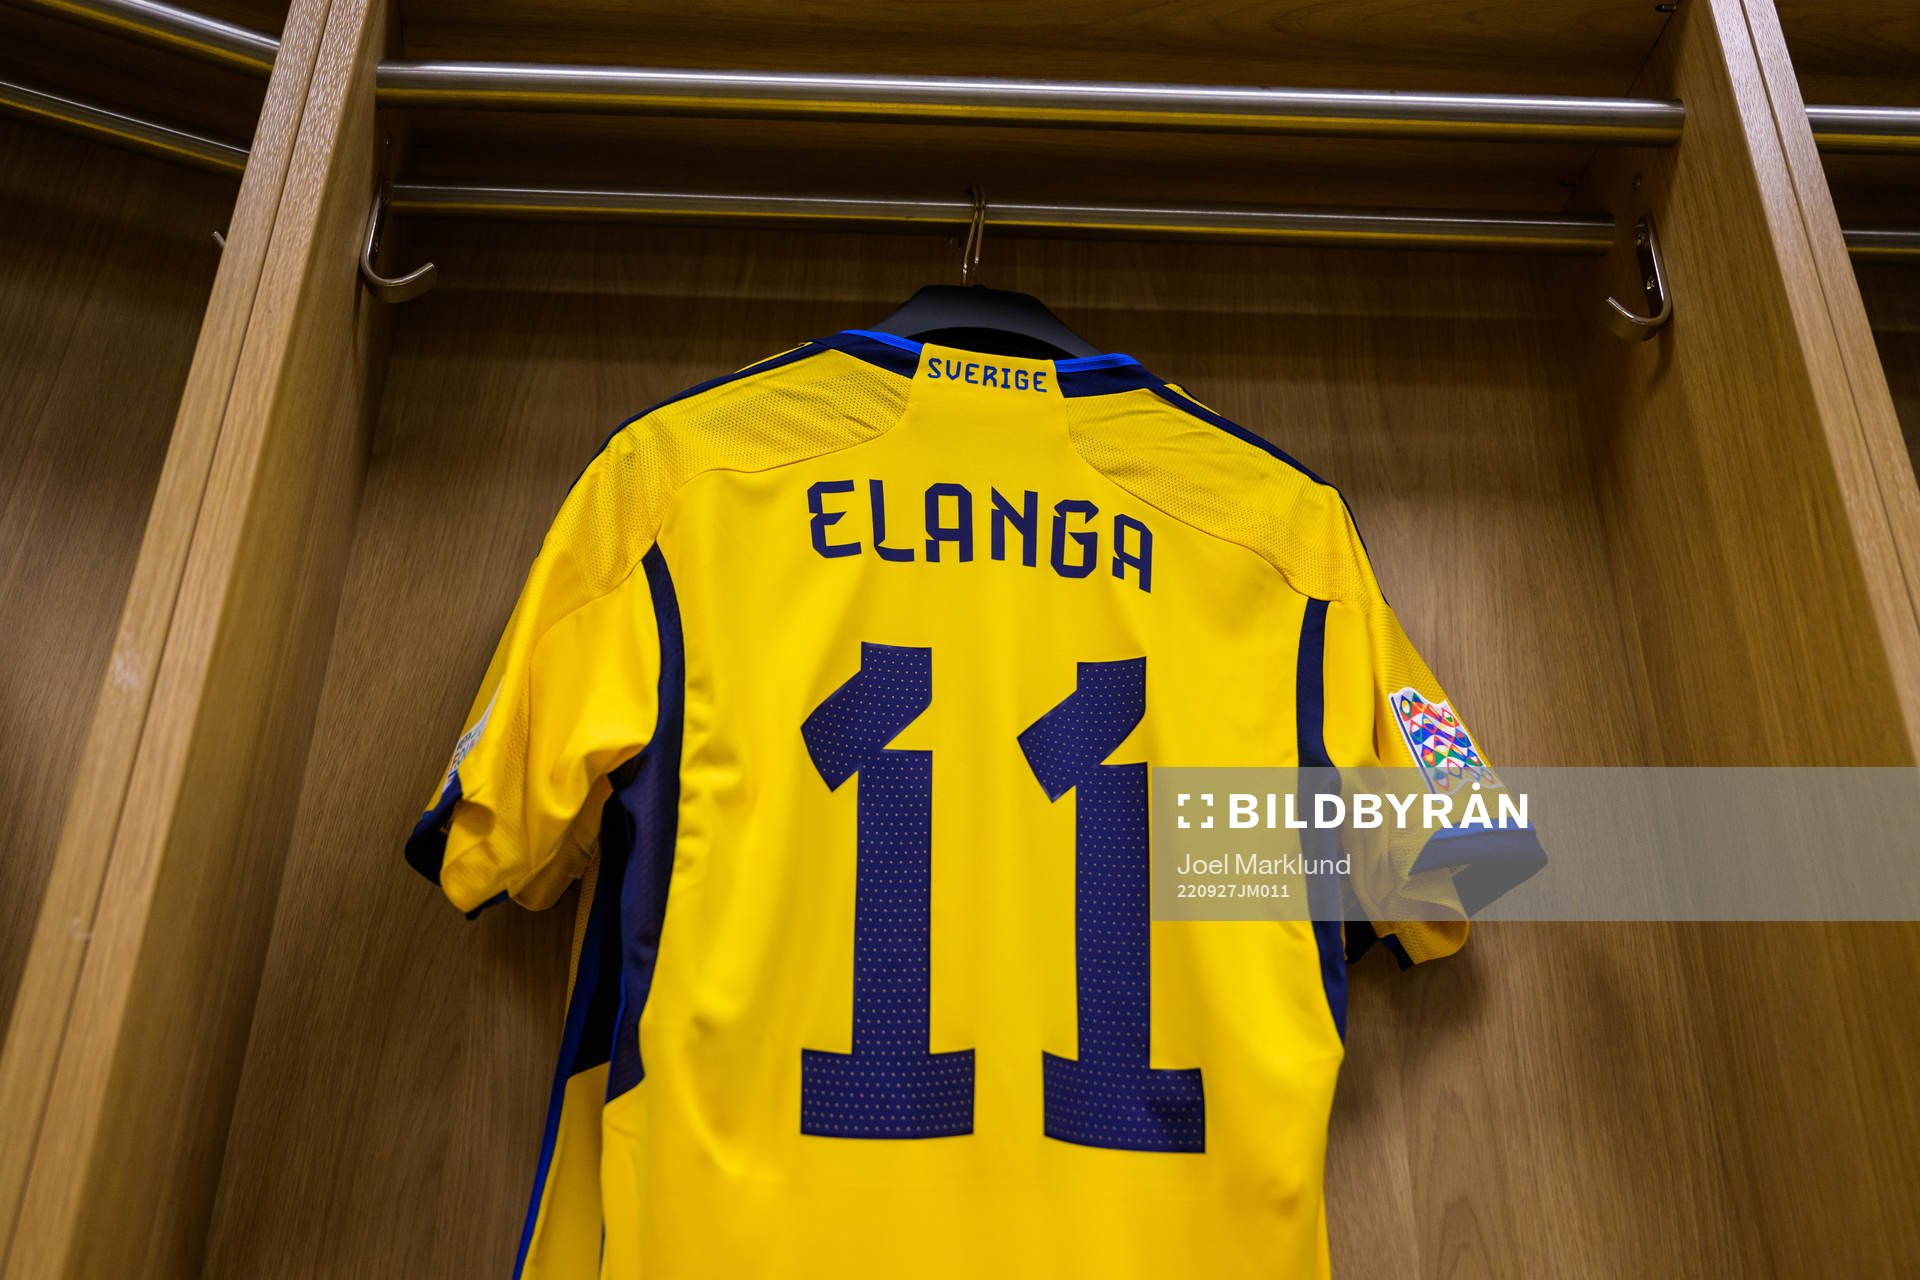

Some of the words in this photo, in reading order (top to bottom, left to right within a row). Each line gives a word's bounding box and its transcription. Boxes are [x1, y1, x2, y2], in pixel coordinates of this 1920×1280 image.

[927, 357, 1048, 393] SVERIGE
[807, 479, 1153, 593] ELANGA
[800, 641, 1206, 1154] 11
